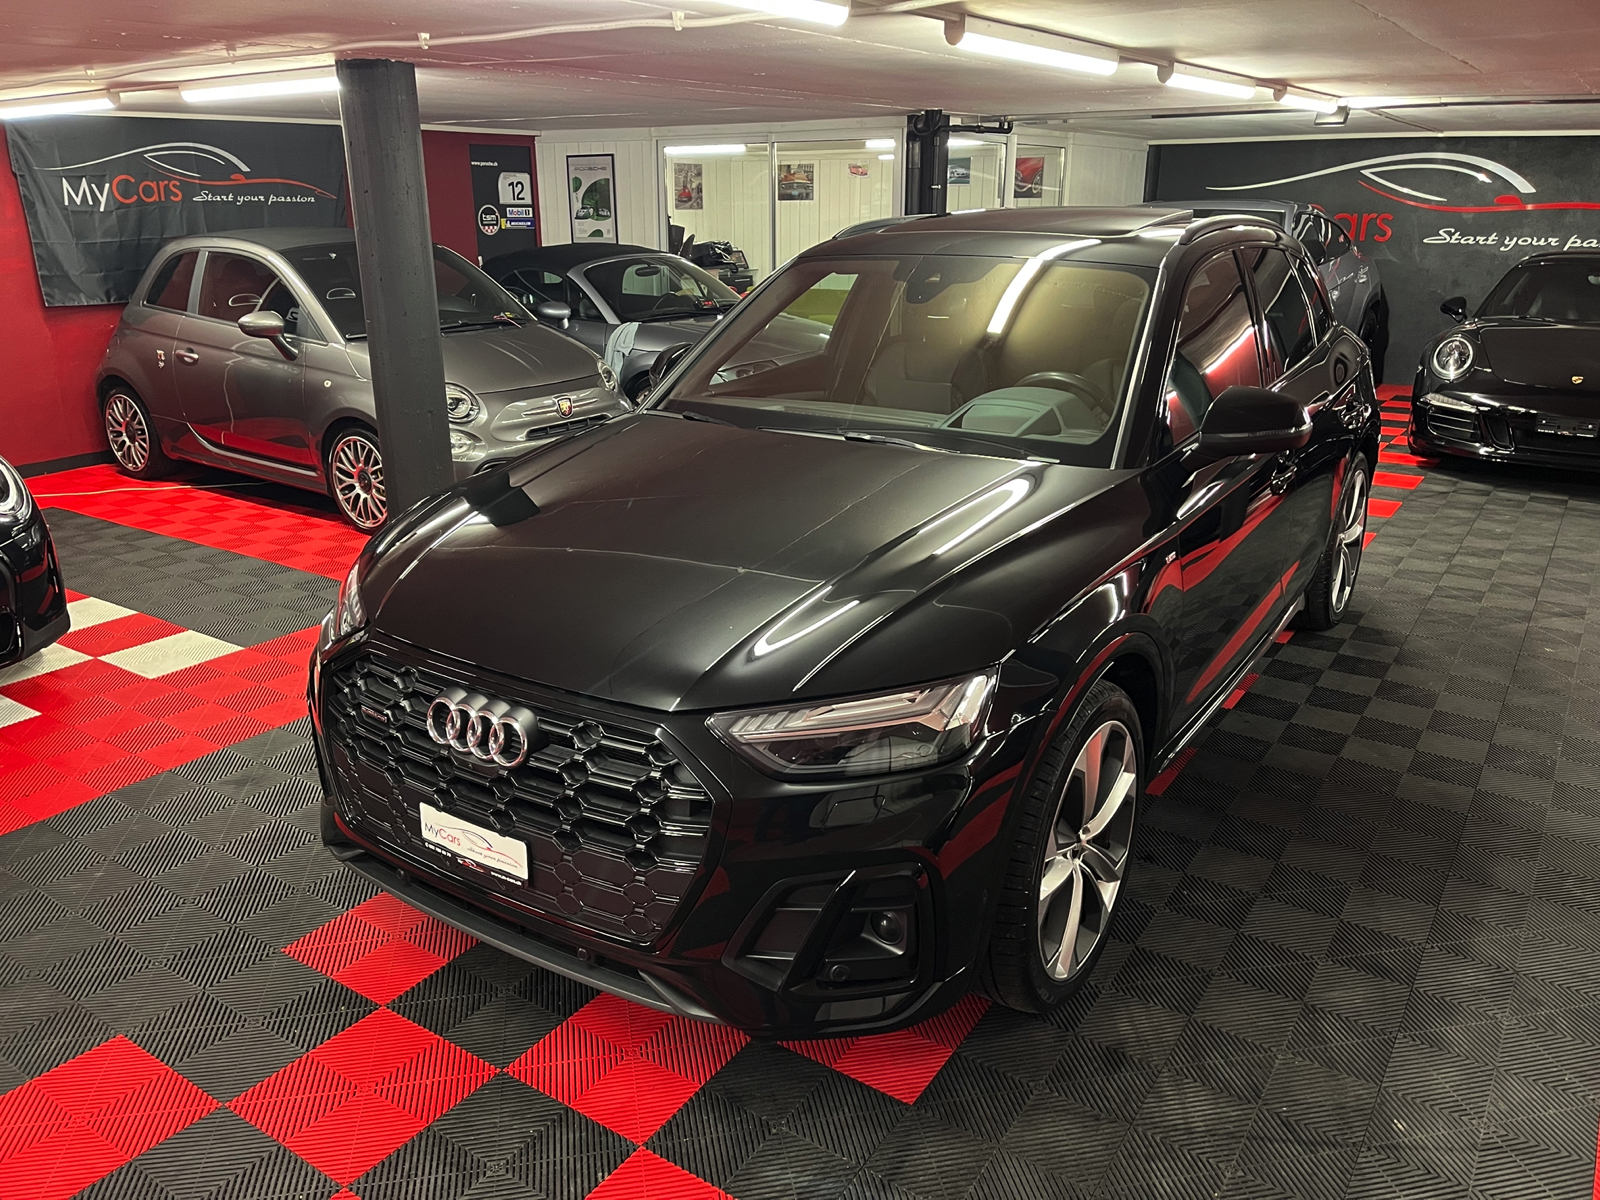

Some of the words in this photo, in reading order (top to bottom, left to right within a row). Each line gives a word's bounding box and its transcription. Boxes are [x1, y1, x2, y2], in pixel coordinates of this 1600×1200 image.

[62, 174, 183, 212] MyCars
[192, 190, 234, 202] Start
[236, 193, 265, 205] your
[268, 193, 316, 206] passion
[508, 181, 525, 201] 12
[508, 208, 524, 217] Mobil
[1422, 227, 1499, 244] Start
[1500, 234, 1560, 251] your
[1563, 233, 1600, 251] pa
[424, 822, 462, 847] MyCars
